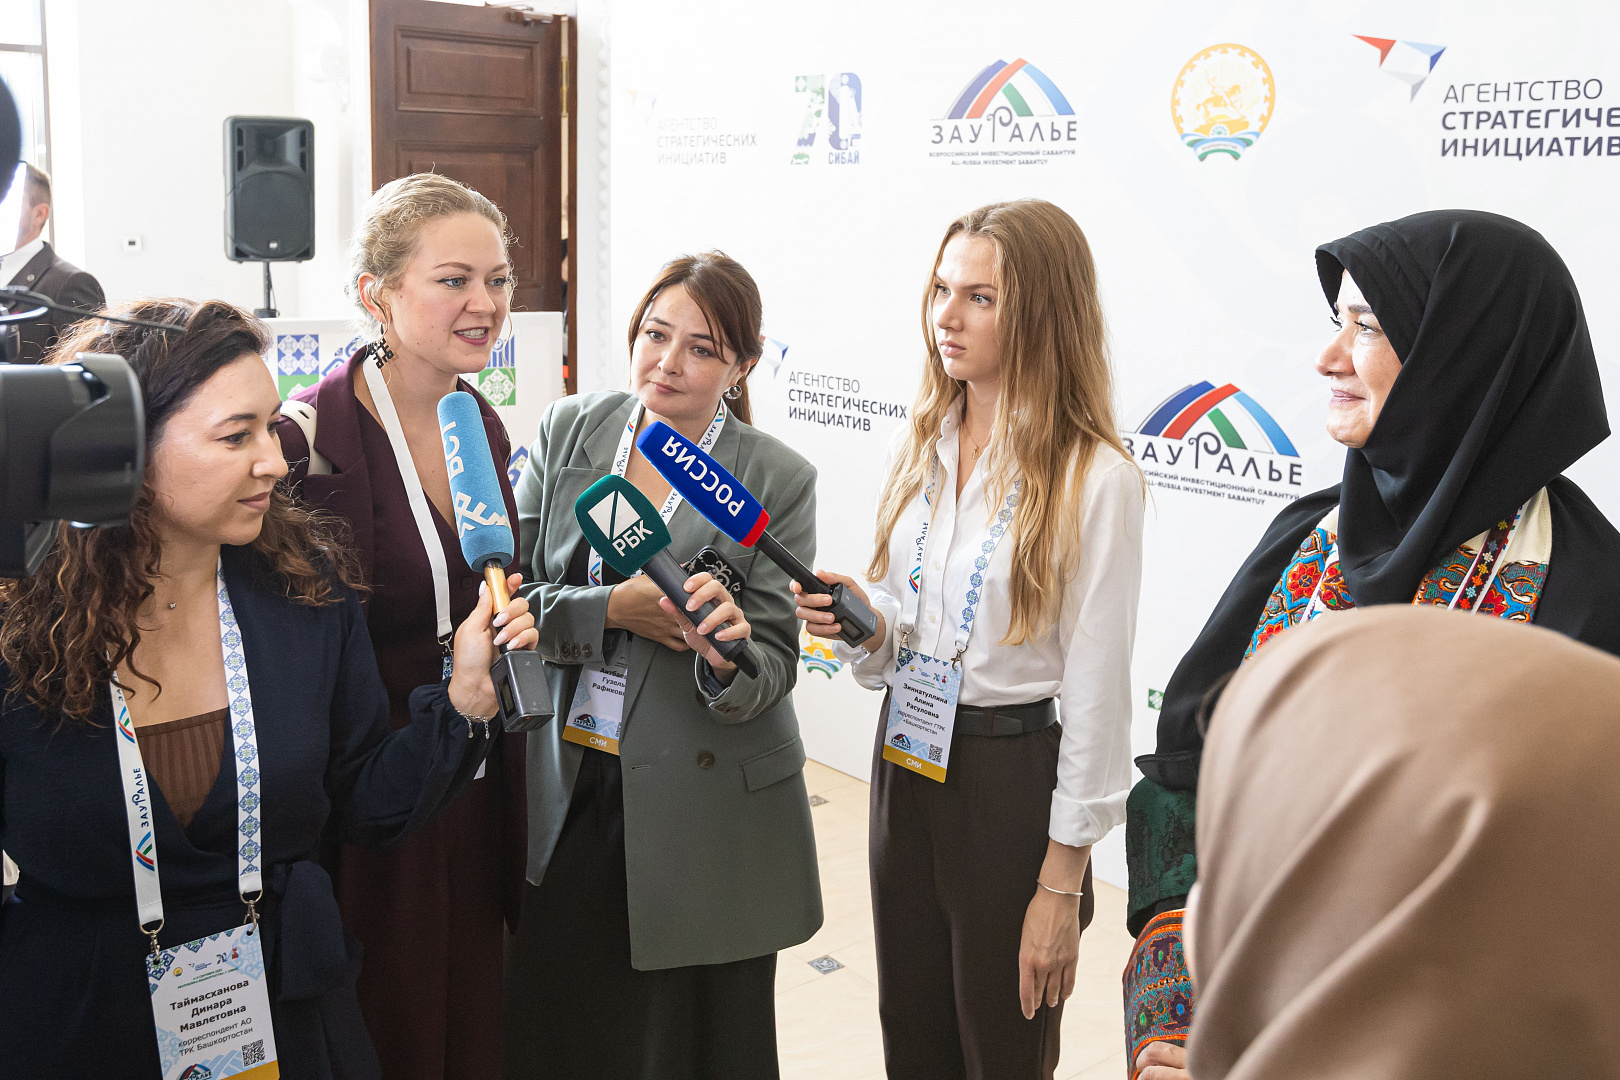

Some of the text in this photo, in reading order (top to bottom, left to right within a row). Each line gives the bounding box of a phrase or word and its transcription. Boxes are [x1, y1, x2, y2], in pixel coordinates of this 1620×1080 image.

[1443, 78, 1603, 104] АГЕНТСТВО
[657, 117, 718, 131] АГЕНТСТВО
[931, 106, 1077, 144] ЗАУРАЛЬЕ
[657, 133, 757, 148] СТРАТЕГИЧЕСКИХ
[1441, 136, 1620, 161] ИНИЦИАТИВ
[657, 152, 727, 165] ИНИЦИАТИВ
[828, 151, 860, 165] СИБАЙ
[788, 371, 860, 394] АГЕНТСТВО
[788, 388, 907, 419] СТРАТЕГИЧЕСКИХ
[788, 405, 871, 432] ИНИЦИАТИВ
[1122, 431, 1302, 486] ЗАУРАЛЬЕ
[661, 435, 745, 518] РОССИЯ
[1143, 469, 1301, 501] СИЙСКИЙ ИНВЕСТИЦИОННЫЙ САВАНТУЙ
[1148, 480, 1265, 506] LL-RUSSIA INVESTMENT SABANTUY
[611, 519, 654, 557] РБК
[915, 521, 929, 562] ЗАУРАЛЬЕ
[903, 682, 948, 705] Зиннатуллина
[914, 696, 934, 708] Алина
[906, 701, 939, 719] Расуловна
[589, 736, 608, 748] СМИ
[905, 757, 922, 770] СМИ
[132, 767, 150, 828] ЗАУРАЛЬЕ
[170, 979, 250, 1011] Таймасханова
[191, 997, 233, 1018] Динара
[180, 1005, 247, 1033] Мавлетовна
[178, 1017, 252, 1048] корреспондент АО
[179, 1027, 254, 1057] ТРК Башкортостан
